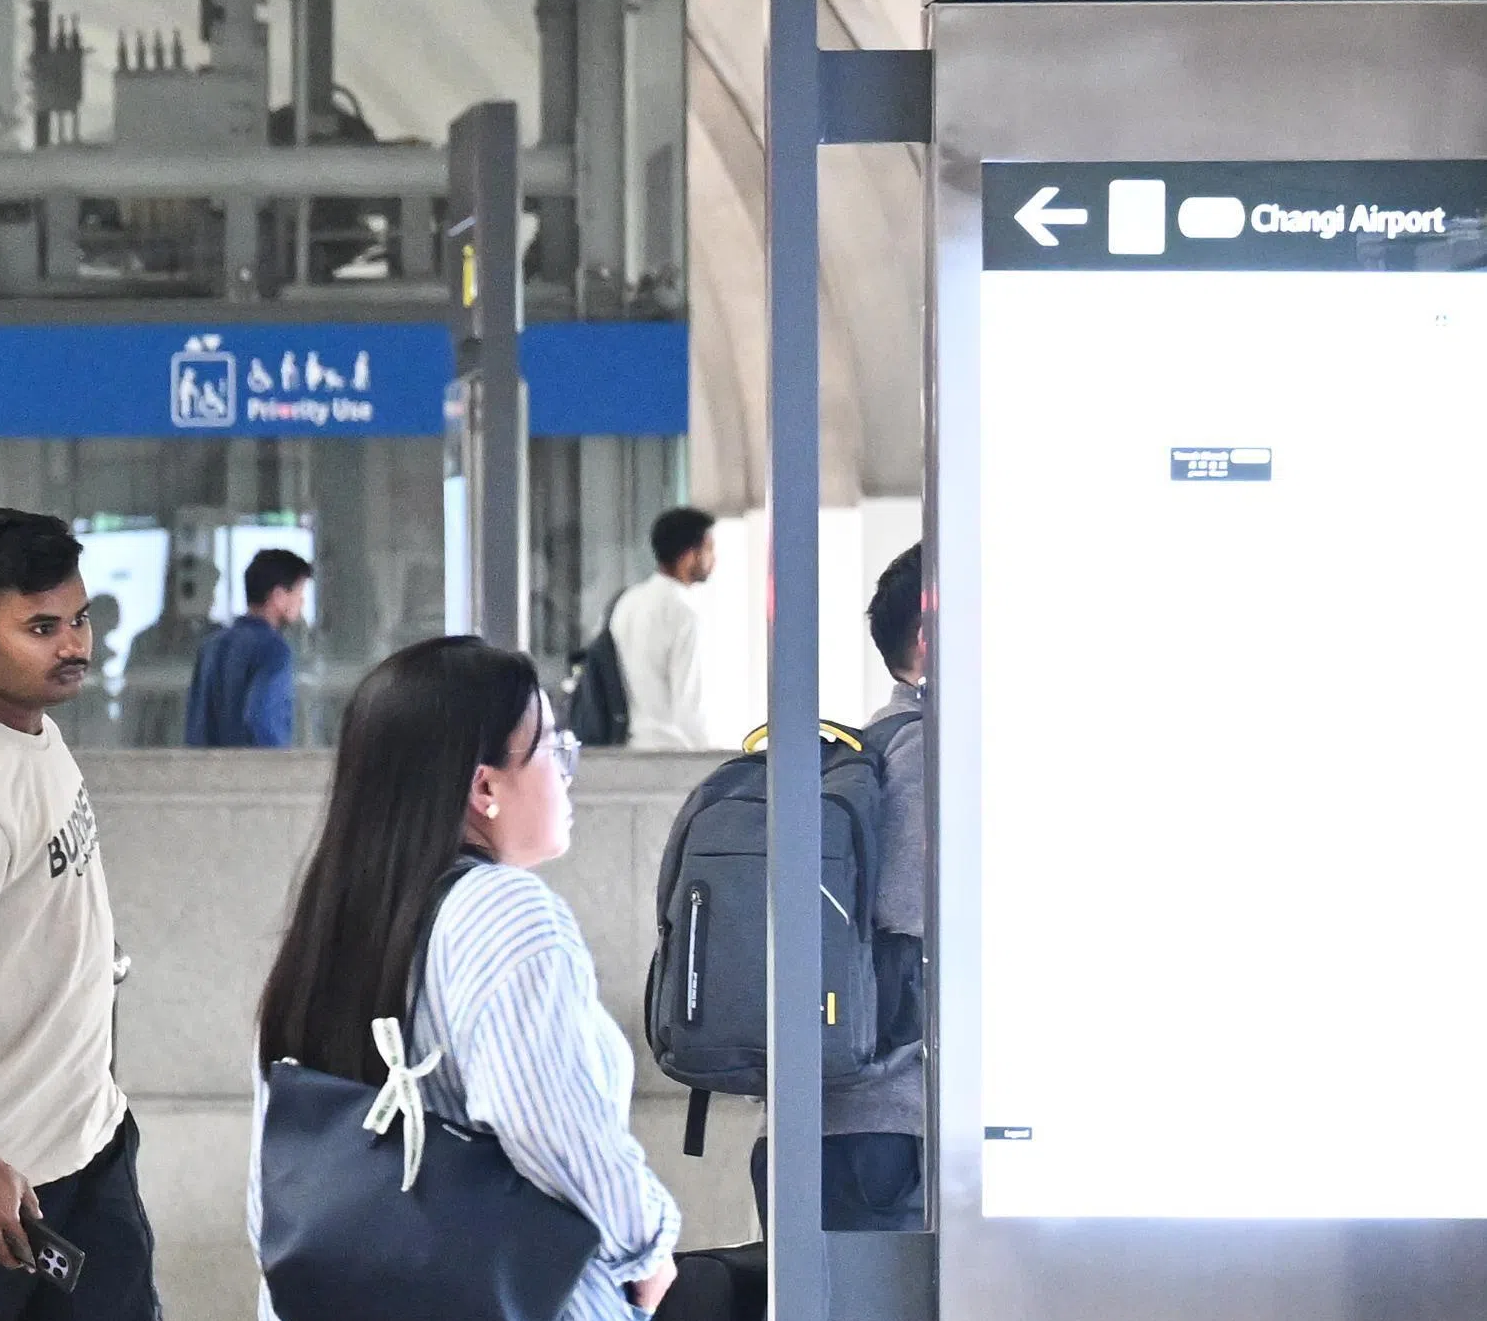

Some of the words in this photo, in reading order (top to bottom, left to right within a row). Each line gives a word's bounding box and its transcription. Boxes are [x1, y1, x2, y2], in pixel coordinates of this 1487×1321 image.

[1251, 204, 1344, 239] Changi
[1349, 204, 1445, 239] Airport
[247, 397, 329, 426] Priority
[332, 397, 372, 422] Use
